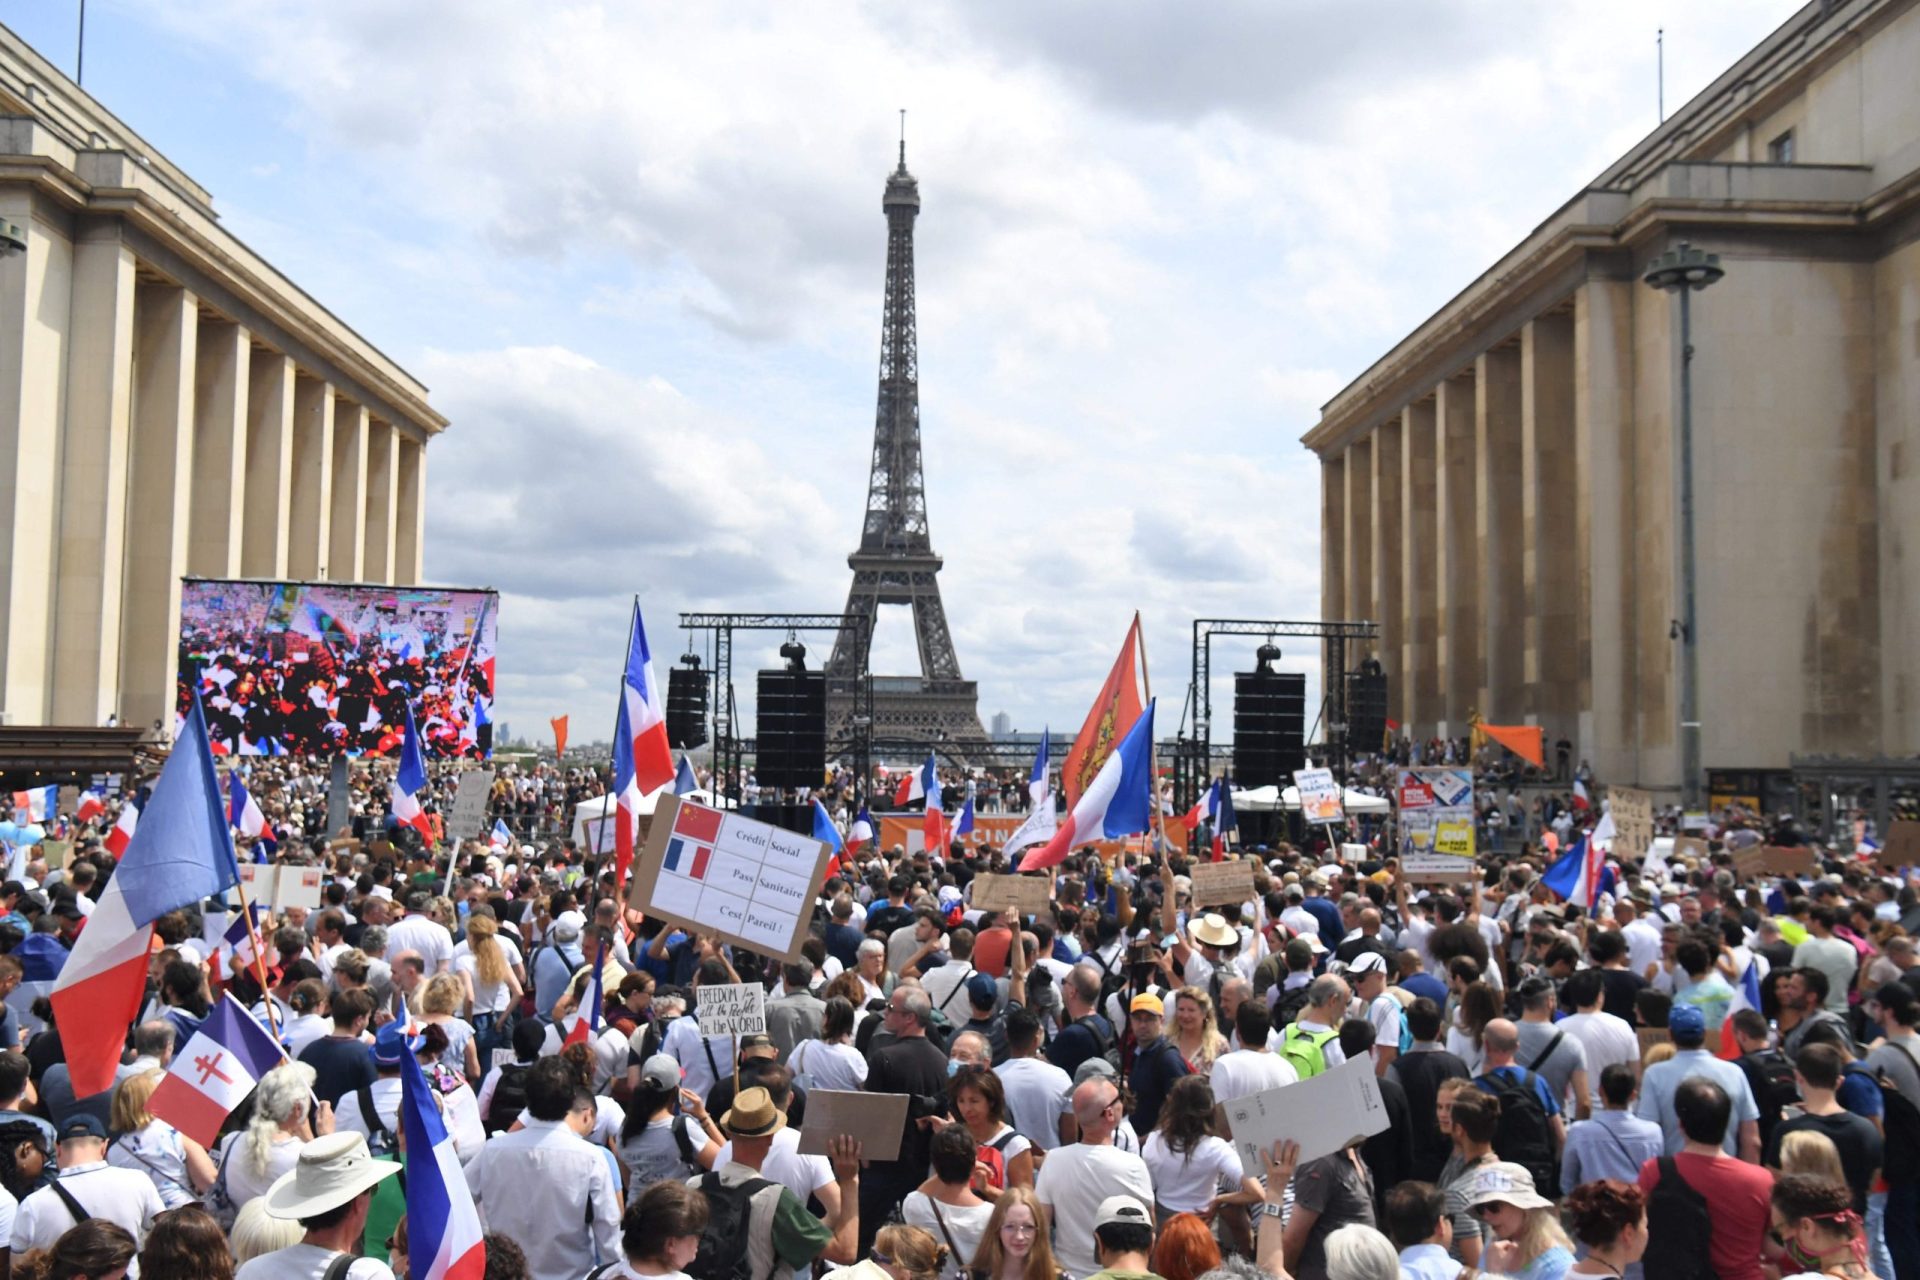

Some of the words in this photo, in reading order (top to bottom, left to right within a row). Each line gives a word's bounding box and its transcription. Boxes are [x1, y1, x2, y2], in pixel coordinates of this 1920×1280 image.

[736, 830, 766, 847] Crédit
[770, 840, 801, 858] Social
[1442, 830, 1467, 841] OUI
[733, 868, 754, 884] Pass
[759, 878, 803, 899] Sanitaire
[719, 905, 743, 921] C'est
[747, 914, 777, 932] Pareil
[698, 987, 737, 1005] FREEDOM
[742, 987, 755, 1001] for
[700, 1004, 714, 1018] all
[717, 1004, 727, 1016] the
[700, 1021, 710, 1035] in
[713, 1020, 726, 1034] the
[727, 1017, 763, 1034] WORLD
